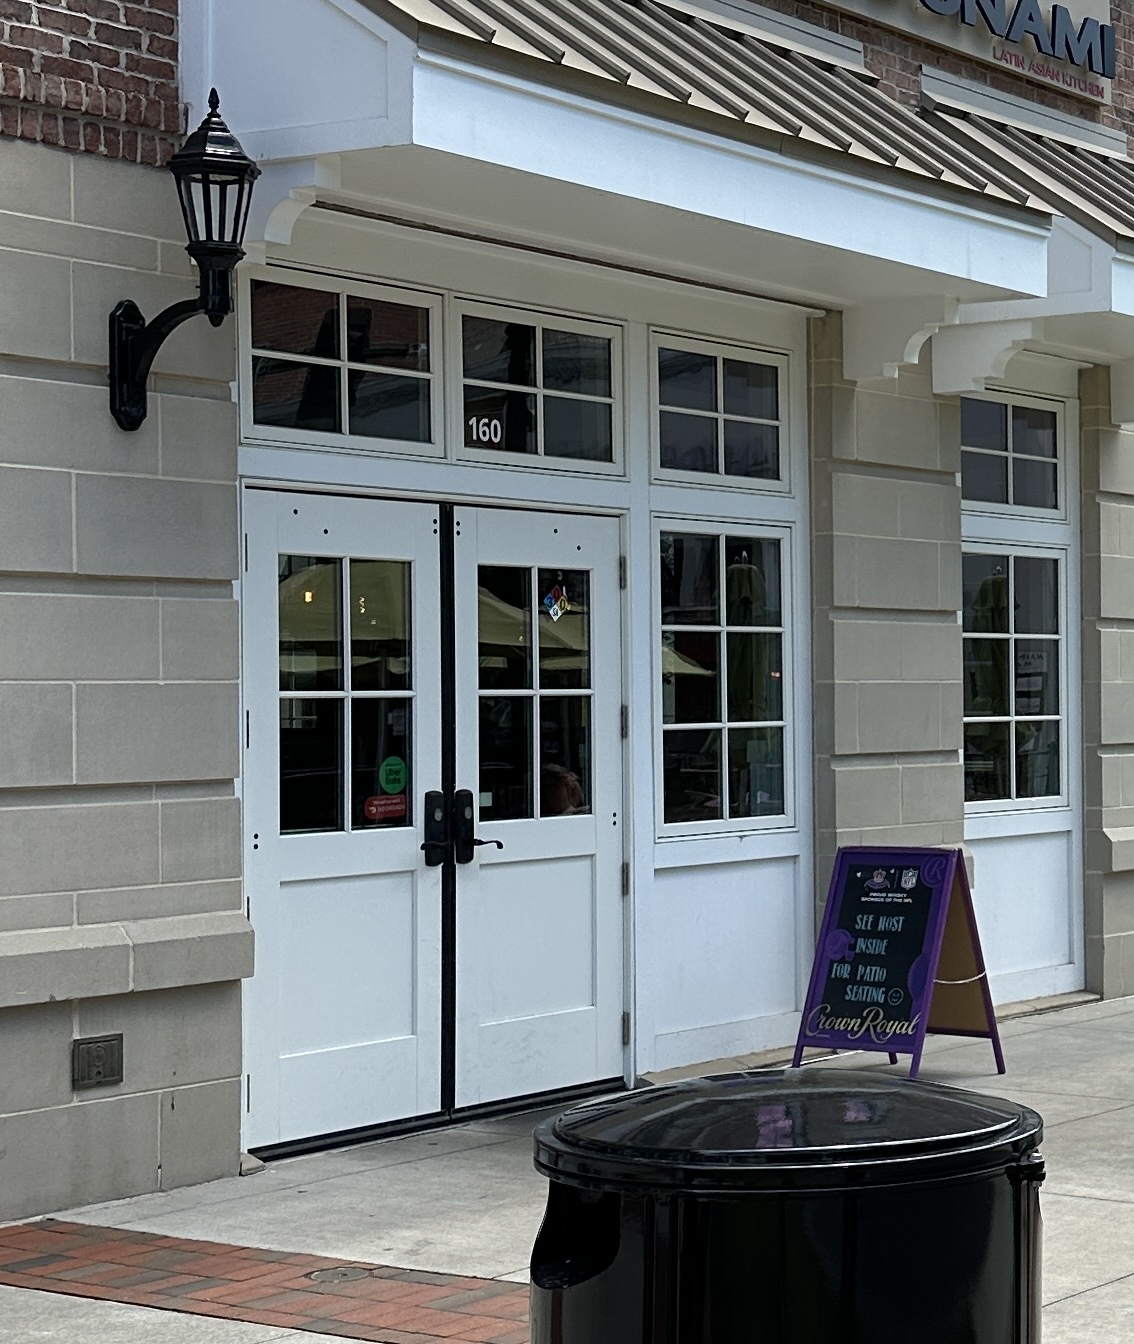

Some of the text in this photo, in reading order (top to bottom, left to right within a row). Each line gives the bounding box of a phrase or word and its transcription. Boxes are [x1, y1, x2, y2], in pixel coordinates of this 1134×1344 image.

[993, 46, 1105, 99] LATIN ASIAN KITCHEN
[469, 417, 501, 443] 160
[855, 914, 905, 932] SEE HOST
[855, 937, 888, 956] INSIDE
[831, 962, 887, 983] FOR PATIO
[845, 984, 886, 1004] SEATING
[805, 1003, 922, 1044] Crown Royal
